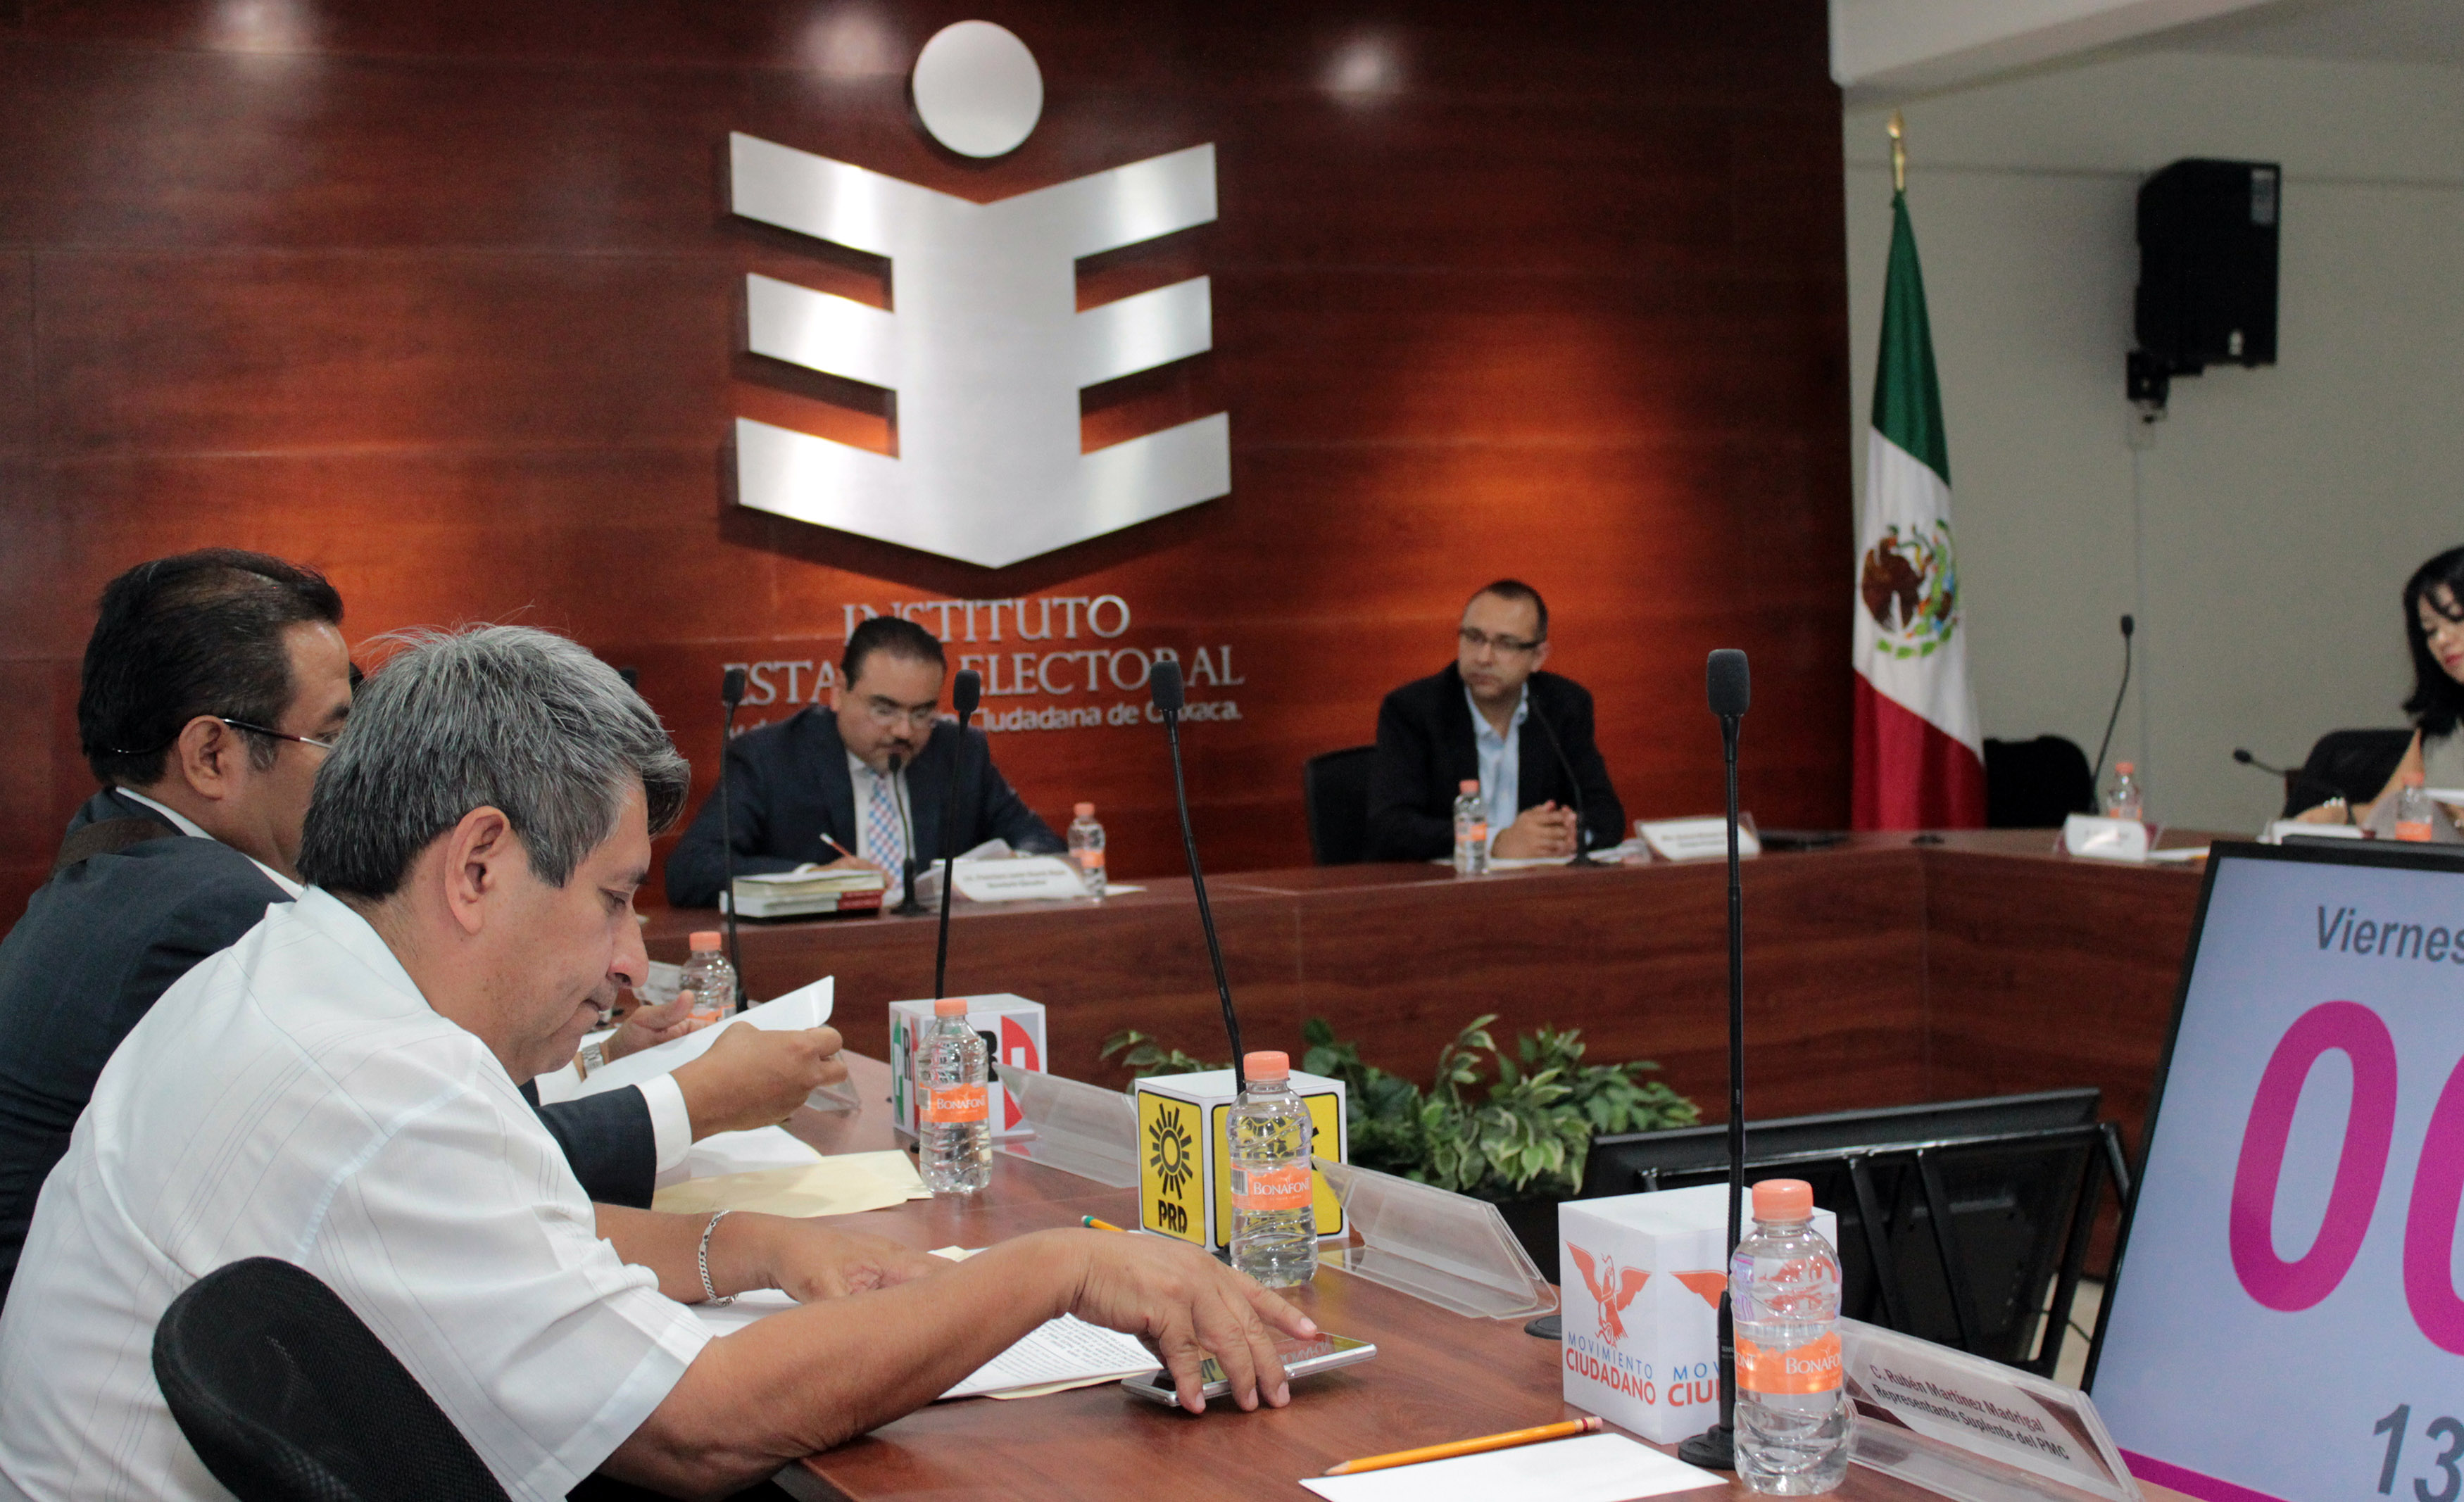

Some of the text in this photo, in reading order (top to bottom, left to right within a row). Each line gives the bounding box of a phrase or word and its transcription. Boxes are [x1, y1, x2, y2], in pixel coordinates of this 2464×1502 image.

[843, 595, 1131, 647] ITITUTO
[1107, 702, 1139, 726] de
[2318, 905, 2464, 964] Viernes
[1254, 1177, 1310, 1196] BONAFONT
[1158, 1199, 1188, 1234] PRD
[1566, 1347, 1657, 1406] CIUDADANO
[1568, 1331, 1653, 1380] MOVIMIENTO
[1785, 1353, 1842, 1375] BONAFO
[1870, 1364, 1887, 1380] C.
[1885, 1368, 1927, 1394] Rubén
[1982, 1400, 2046, 1434] Madrigal
[1872, 1383, 2070, 1460] Representante Suplente del PMC
